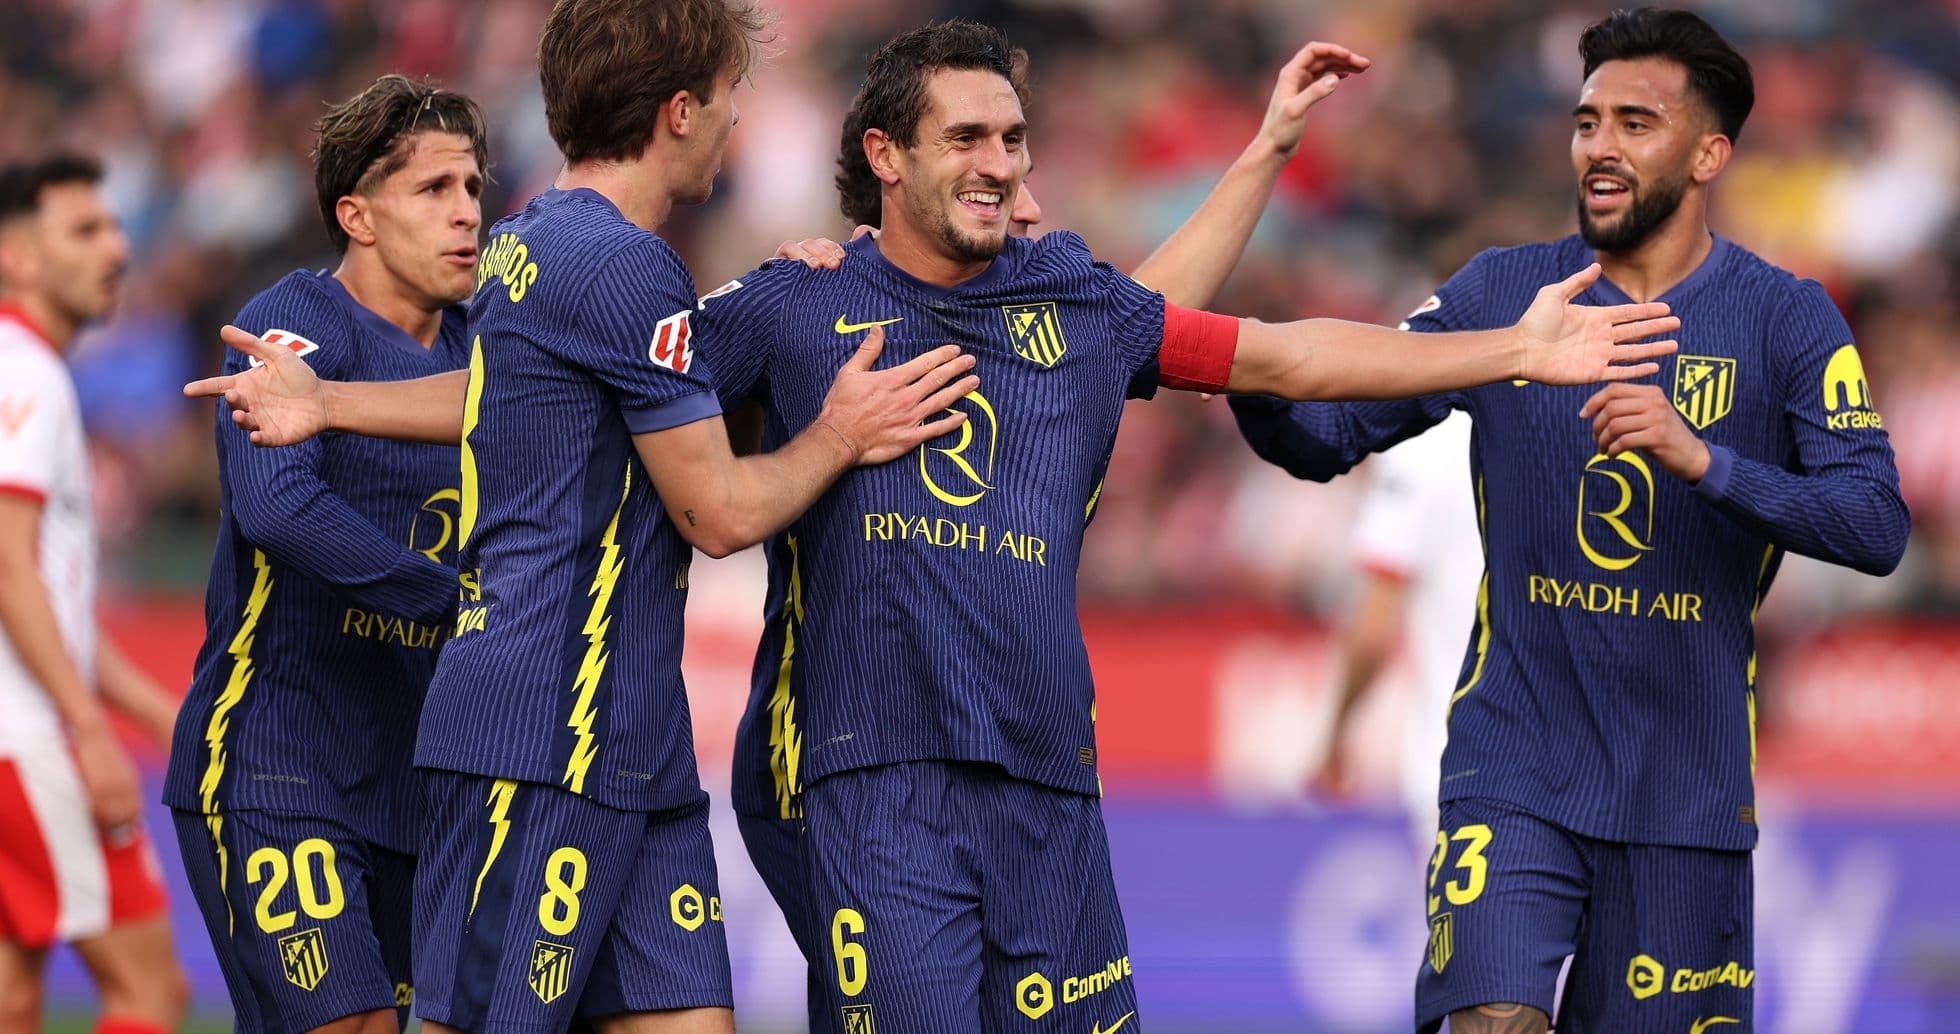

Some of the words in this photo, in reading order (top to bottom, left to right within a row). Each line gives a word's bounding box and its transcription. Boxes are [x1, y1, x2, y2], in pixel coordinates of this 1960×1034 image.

[476, 233, 538, 303] BARRIOS
[1827, 410, 1882, 429] krake
[864, 512, 985, 552] RIYADH
[996, 530, 1046, 567] AIR
[1529, 575, 1639, 616] RIYADH
[1648, 592, 1702, 622] AIR
[343, 608, 440, 649] RIYADH
[247, 838, 345, 934] 20
[539, 847, 587, 936] 8
[1428, 824, 1493, 917] 23
[832, 908, 868, 997] 6
[1063, 956, 1131, 1004] ComAve
[1670, 961, 1755, 993] ComAv
